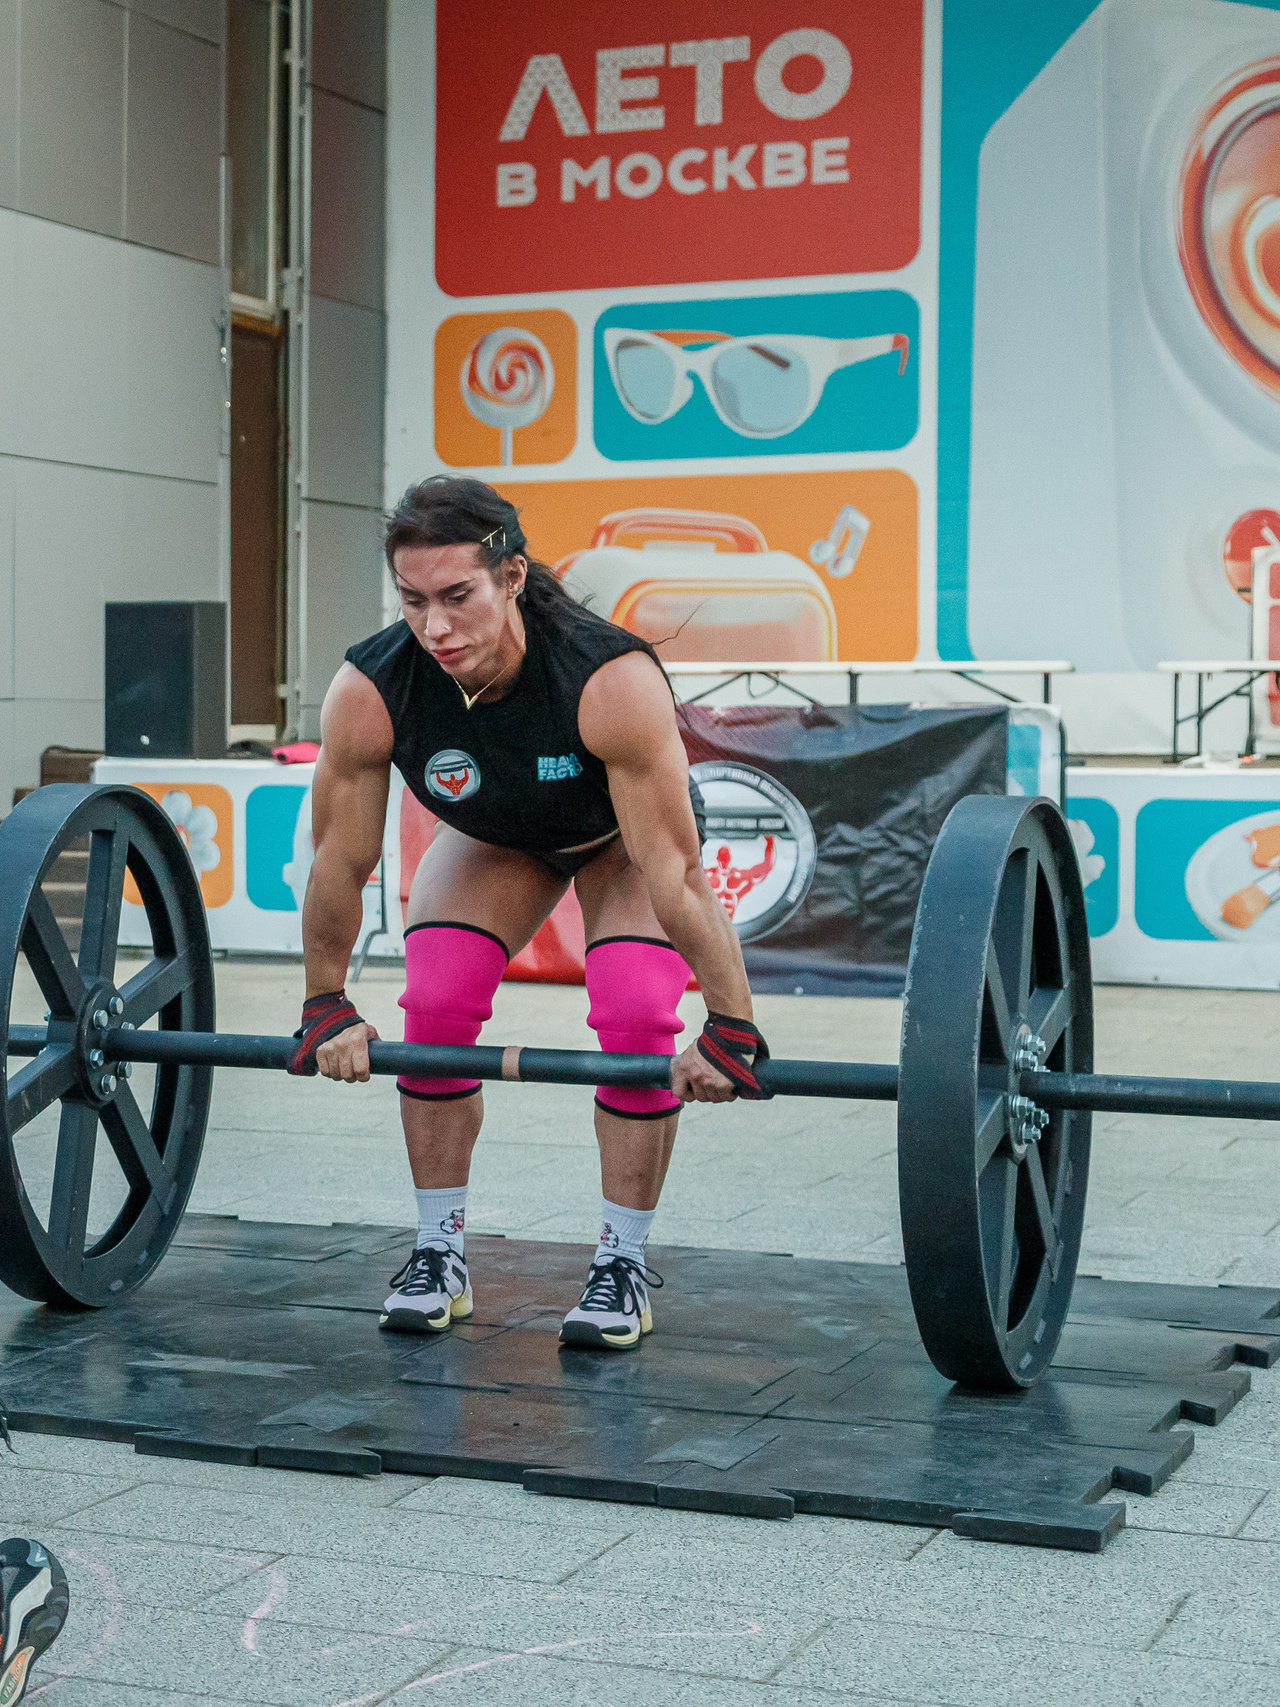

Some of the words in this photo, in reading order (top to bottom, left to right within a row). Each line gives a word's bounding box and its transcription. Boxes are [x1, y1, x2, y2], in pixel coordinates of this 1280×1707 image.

[498, 27, 853, 142] ЛЕТО
[495, 162, 538, 208] В
[560, 136, 851, 203] МОСКВЕ
[3, 1661, 23, 1698] FASHION
